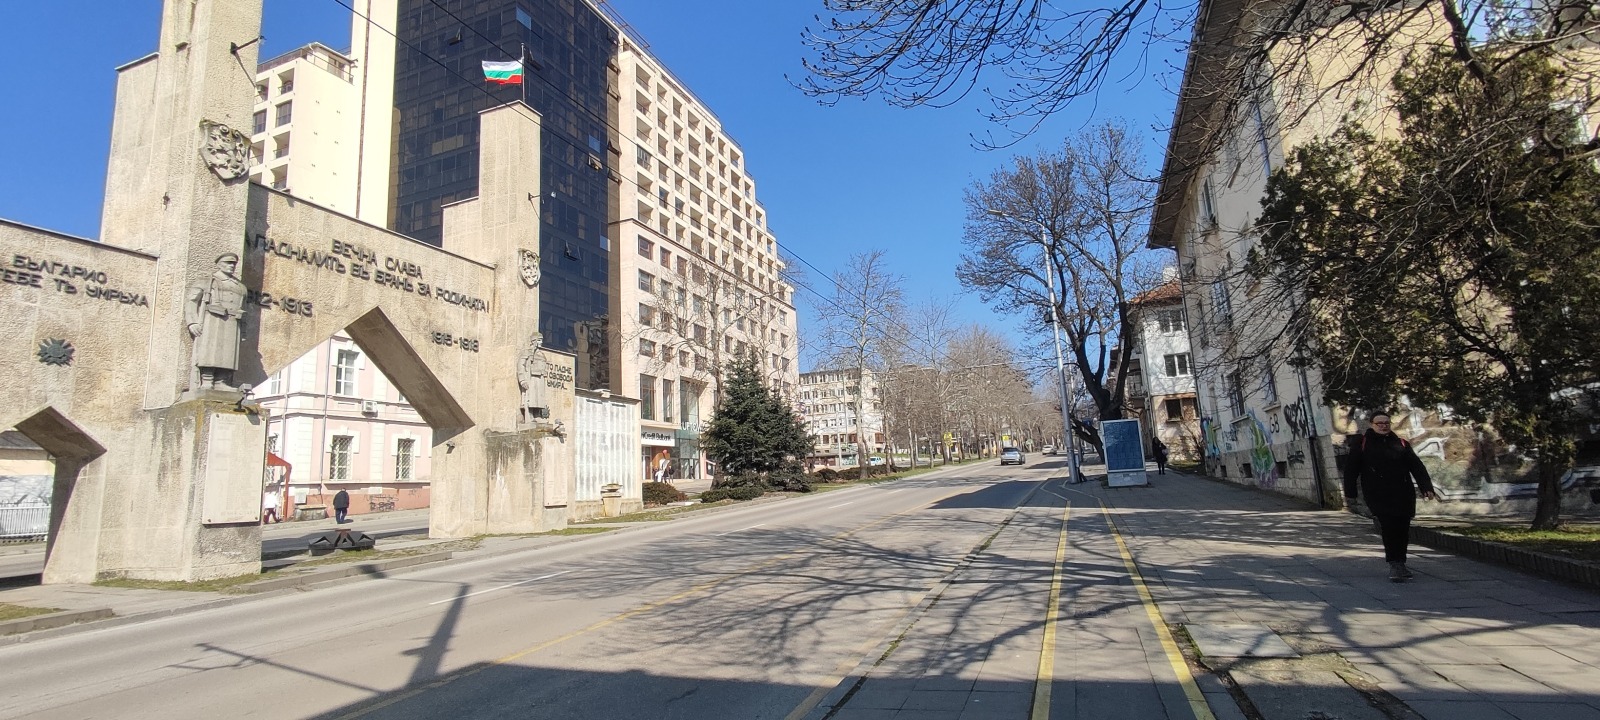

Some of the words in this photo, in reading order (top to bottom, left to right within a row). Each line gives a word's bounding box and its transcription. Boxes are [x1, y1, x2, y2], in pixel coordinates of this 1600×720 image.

[331, 238, 377, 267] ВЕЧНА
[385, 257, 422, 279] СЛАВА
[417, 282, 431, 298] ЗА
